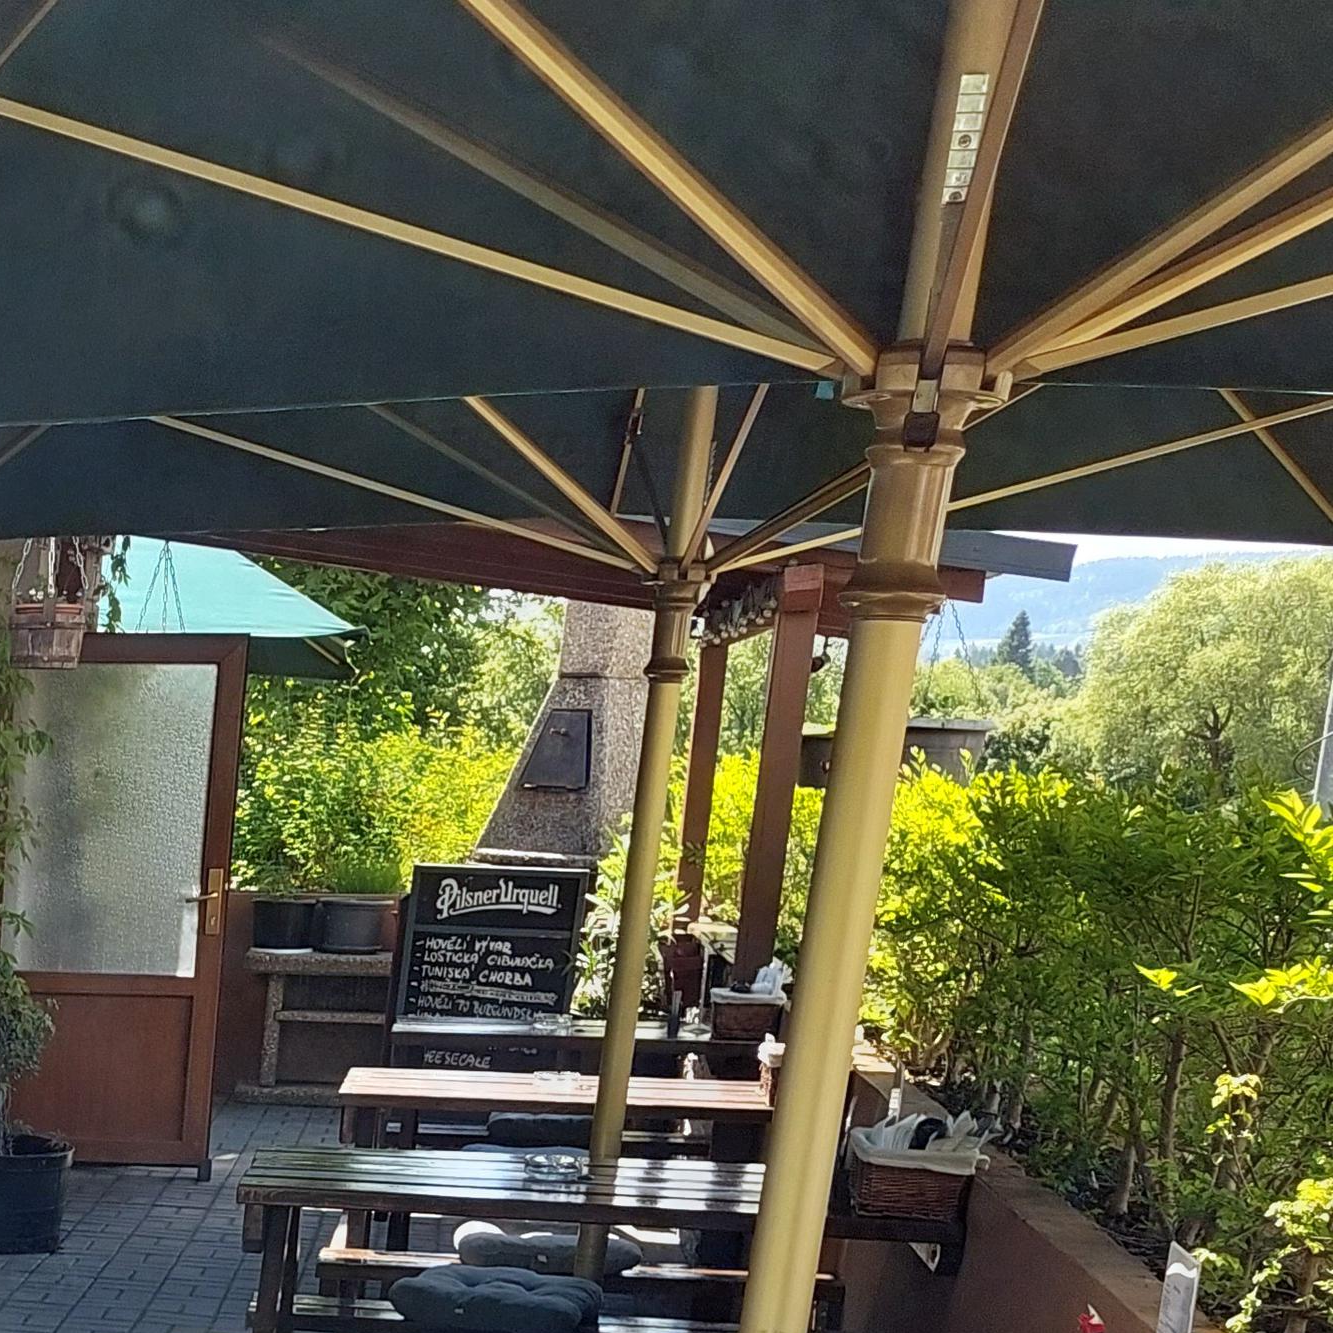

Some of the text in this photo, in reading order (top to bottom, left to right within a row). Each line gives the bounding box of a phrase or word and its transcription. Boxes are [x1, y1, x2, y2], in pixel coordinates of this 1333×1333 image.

[436, 877, 560, 920] Pilsner Urquell
[479, 970, 532, 986] CHORBA
